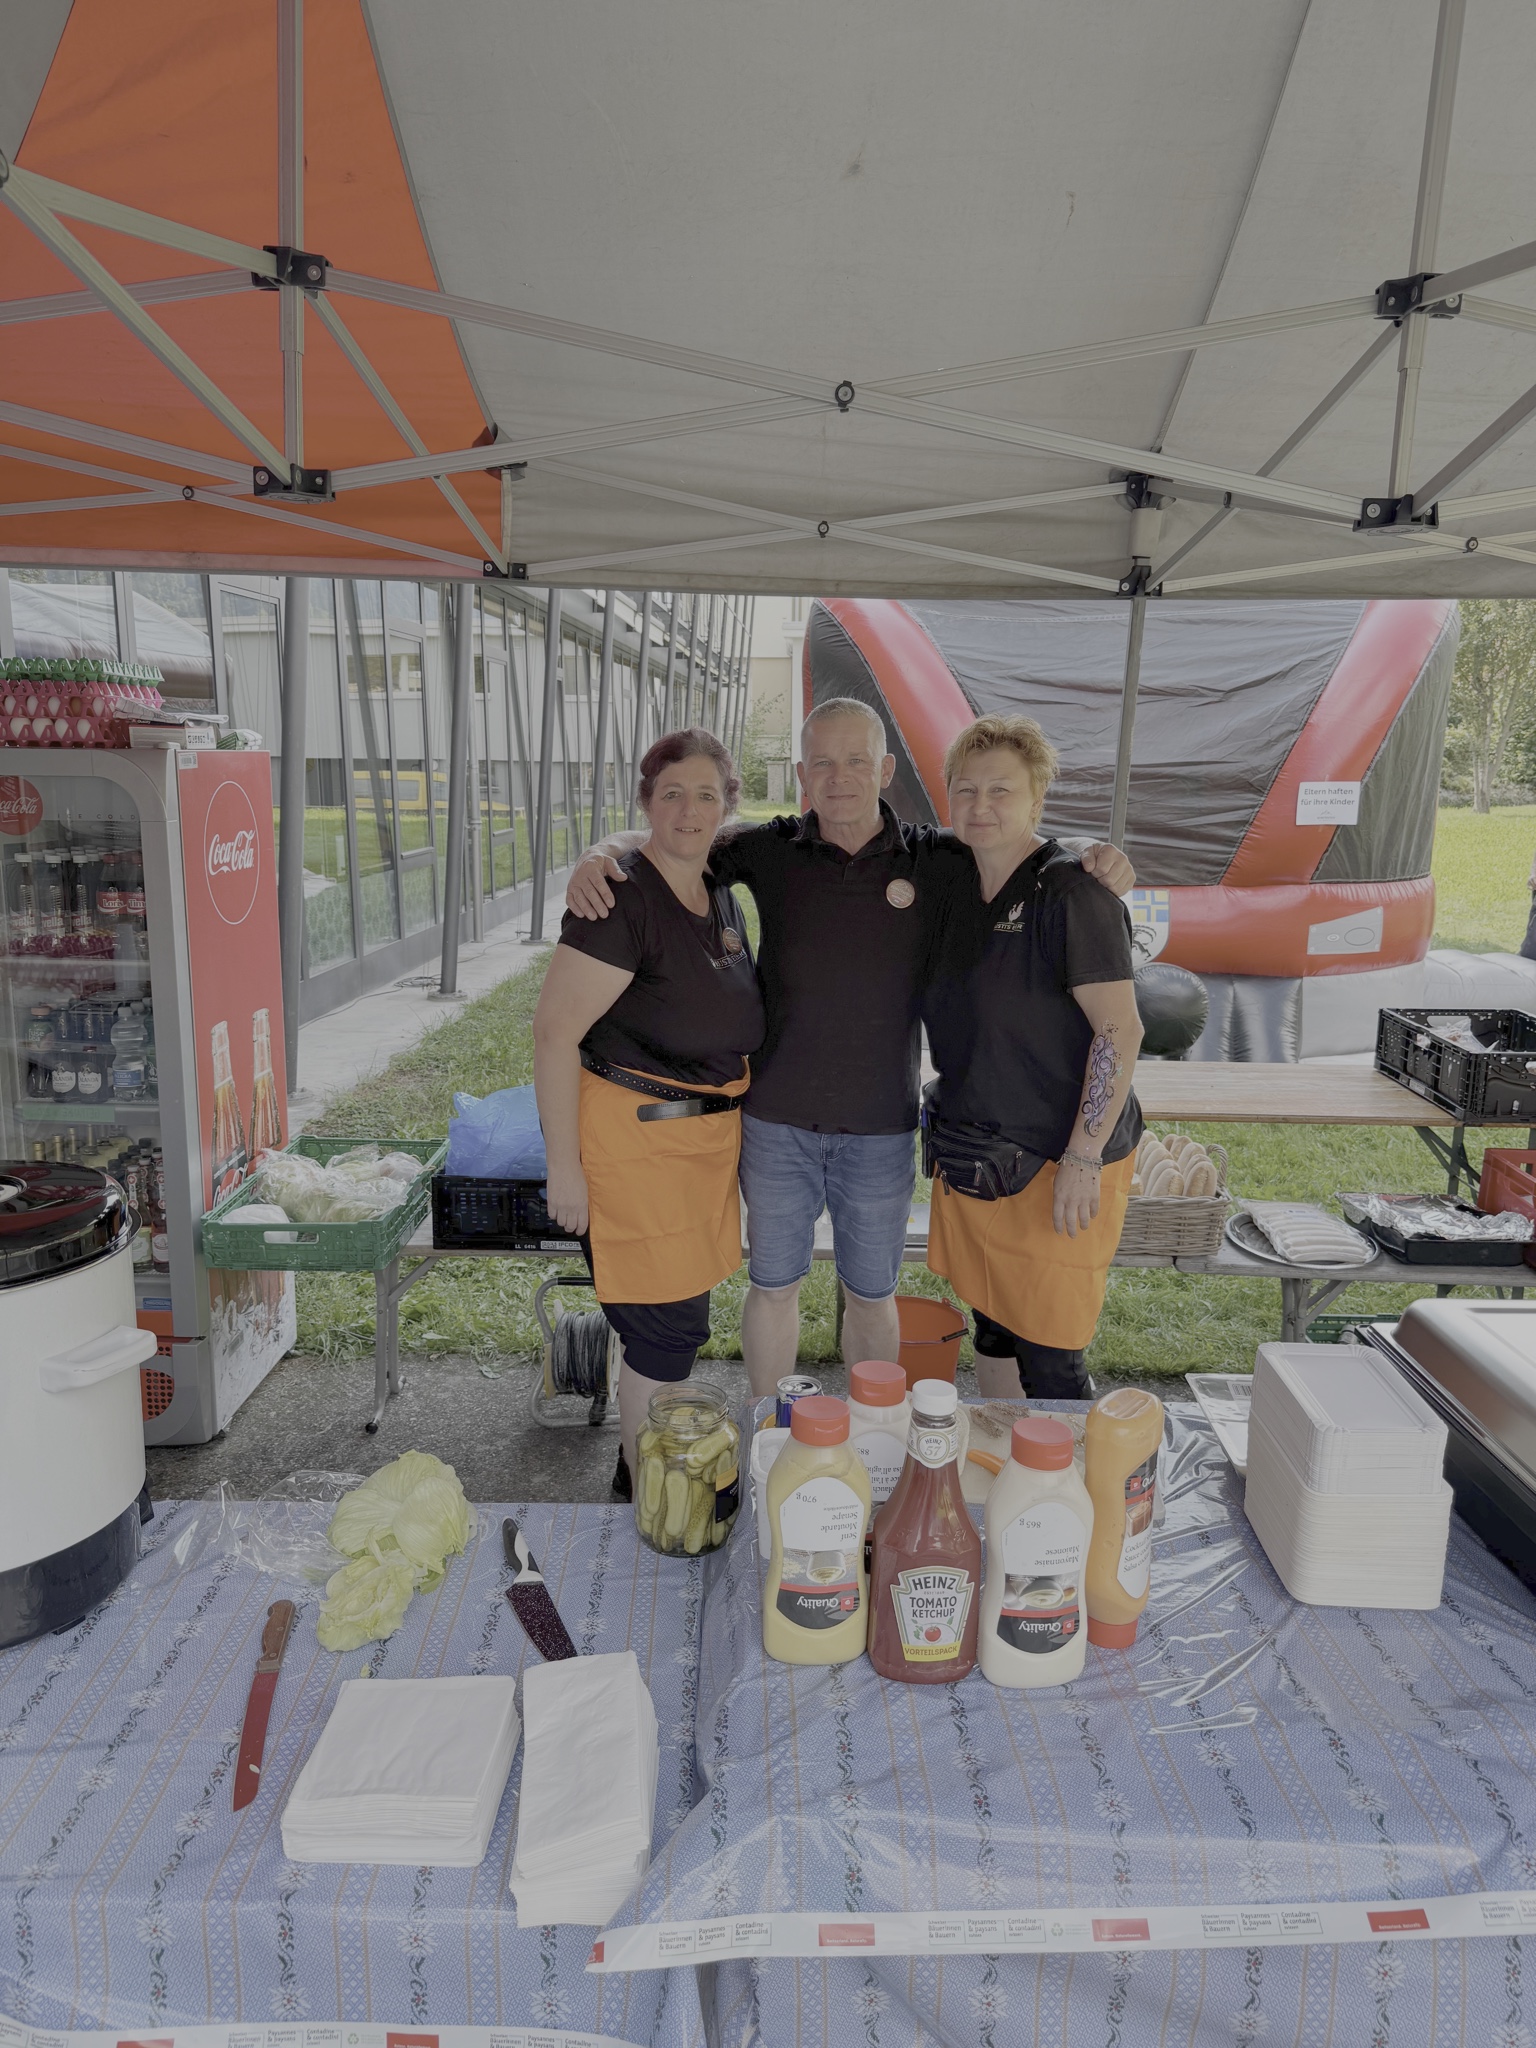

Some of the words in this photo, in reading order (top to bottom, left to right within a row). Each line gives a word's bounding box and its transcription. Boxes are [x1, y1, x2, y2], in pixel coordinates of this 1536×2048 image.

[0, 796, 40, 815] ca-Cola
[208, 829, 255, 876] Coca-Cola
[924, 1437, 943, 1446] HEINZ
[924, 1446, 942, 1457] 57
[796, 1492, 801, 1500] g
[802, 1495, 817, 1503] 970
[831, 1512, 858, 1521] Senape
[820, 1521, 857, 1531] Moutarde
[1019, 1518, 1025, 1526] g
[1026, 1520, 1041, 1528] 865
[840, 1532, 857, 1542] Senf
[1045, 1545, 1080, 1556] Maionese
[1034, 1556, 1079, 1567] Mayonnaise
[911, 1575, 957, 1591] HEINZ
[796, 1596, 839, 1609] Quality
[909, 1595, 957, 1608] TOMATO
[912, 1608, 955, 1619] KETCHUP
[1018, 1620, 1061, 1633] Quality
[904, 1645, 958, 1656] VORTEILSPACK
[1240, 1912, 1270, 1920] Paysannes
[1249, 1919, 1272, 1927] paysans
[698, 1926, 726, 1934] Paysannes
[974, 1925, 997, 1933] paysans
[705, 1933, 726, 1941] paysans
